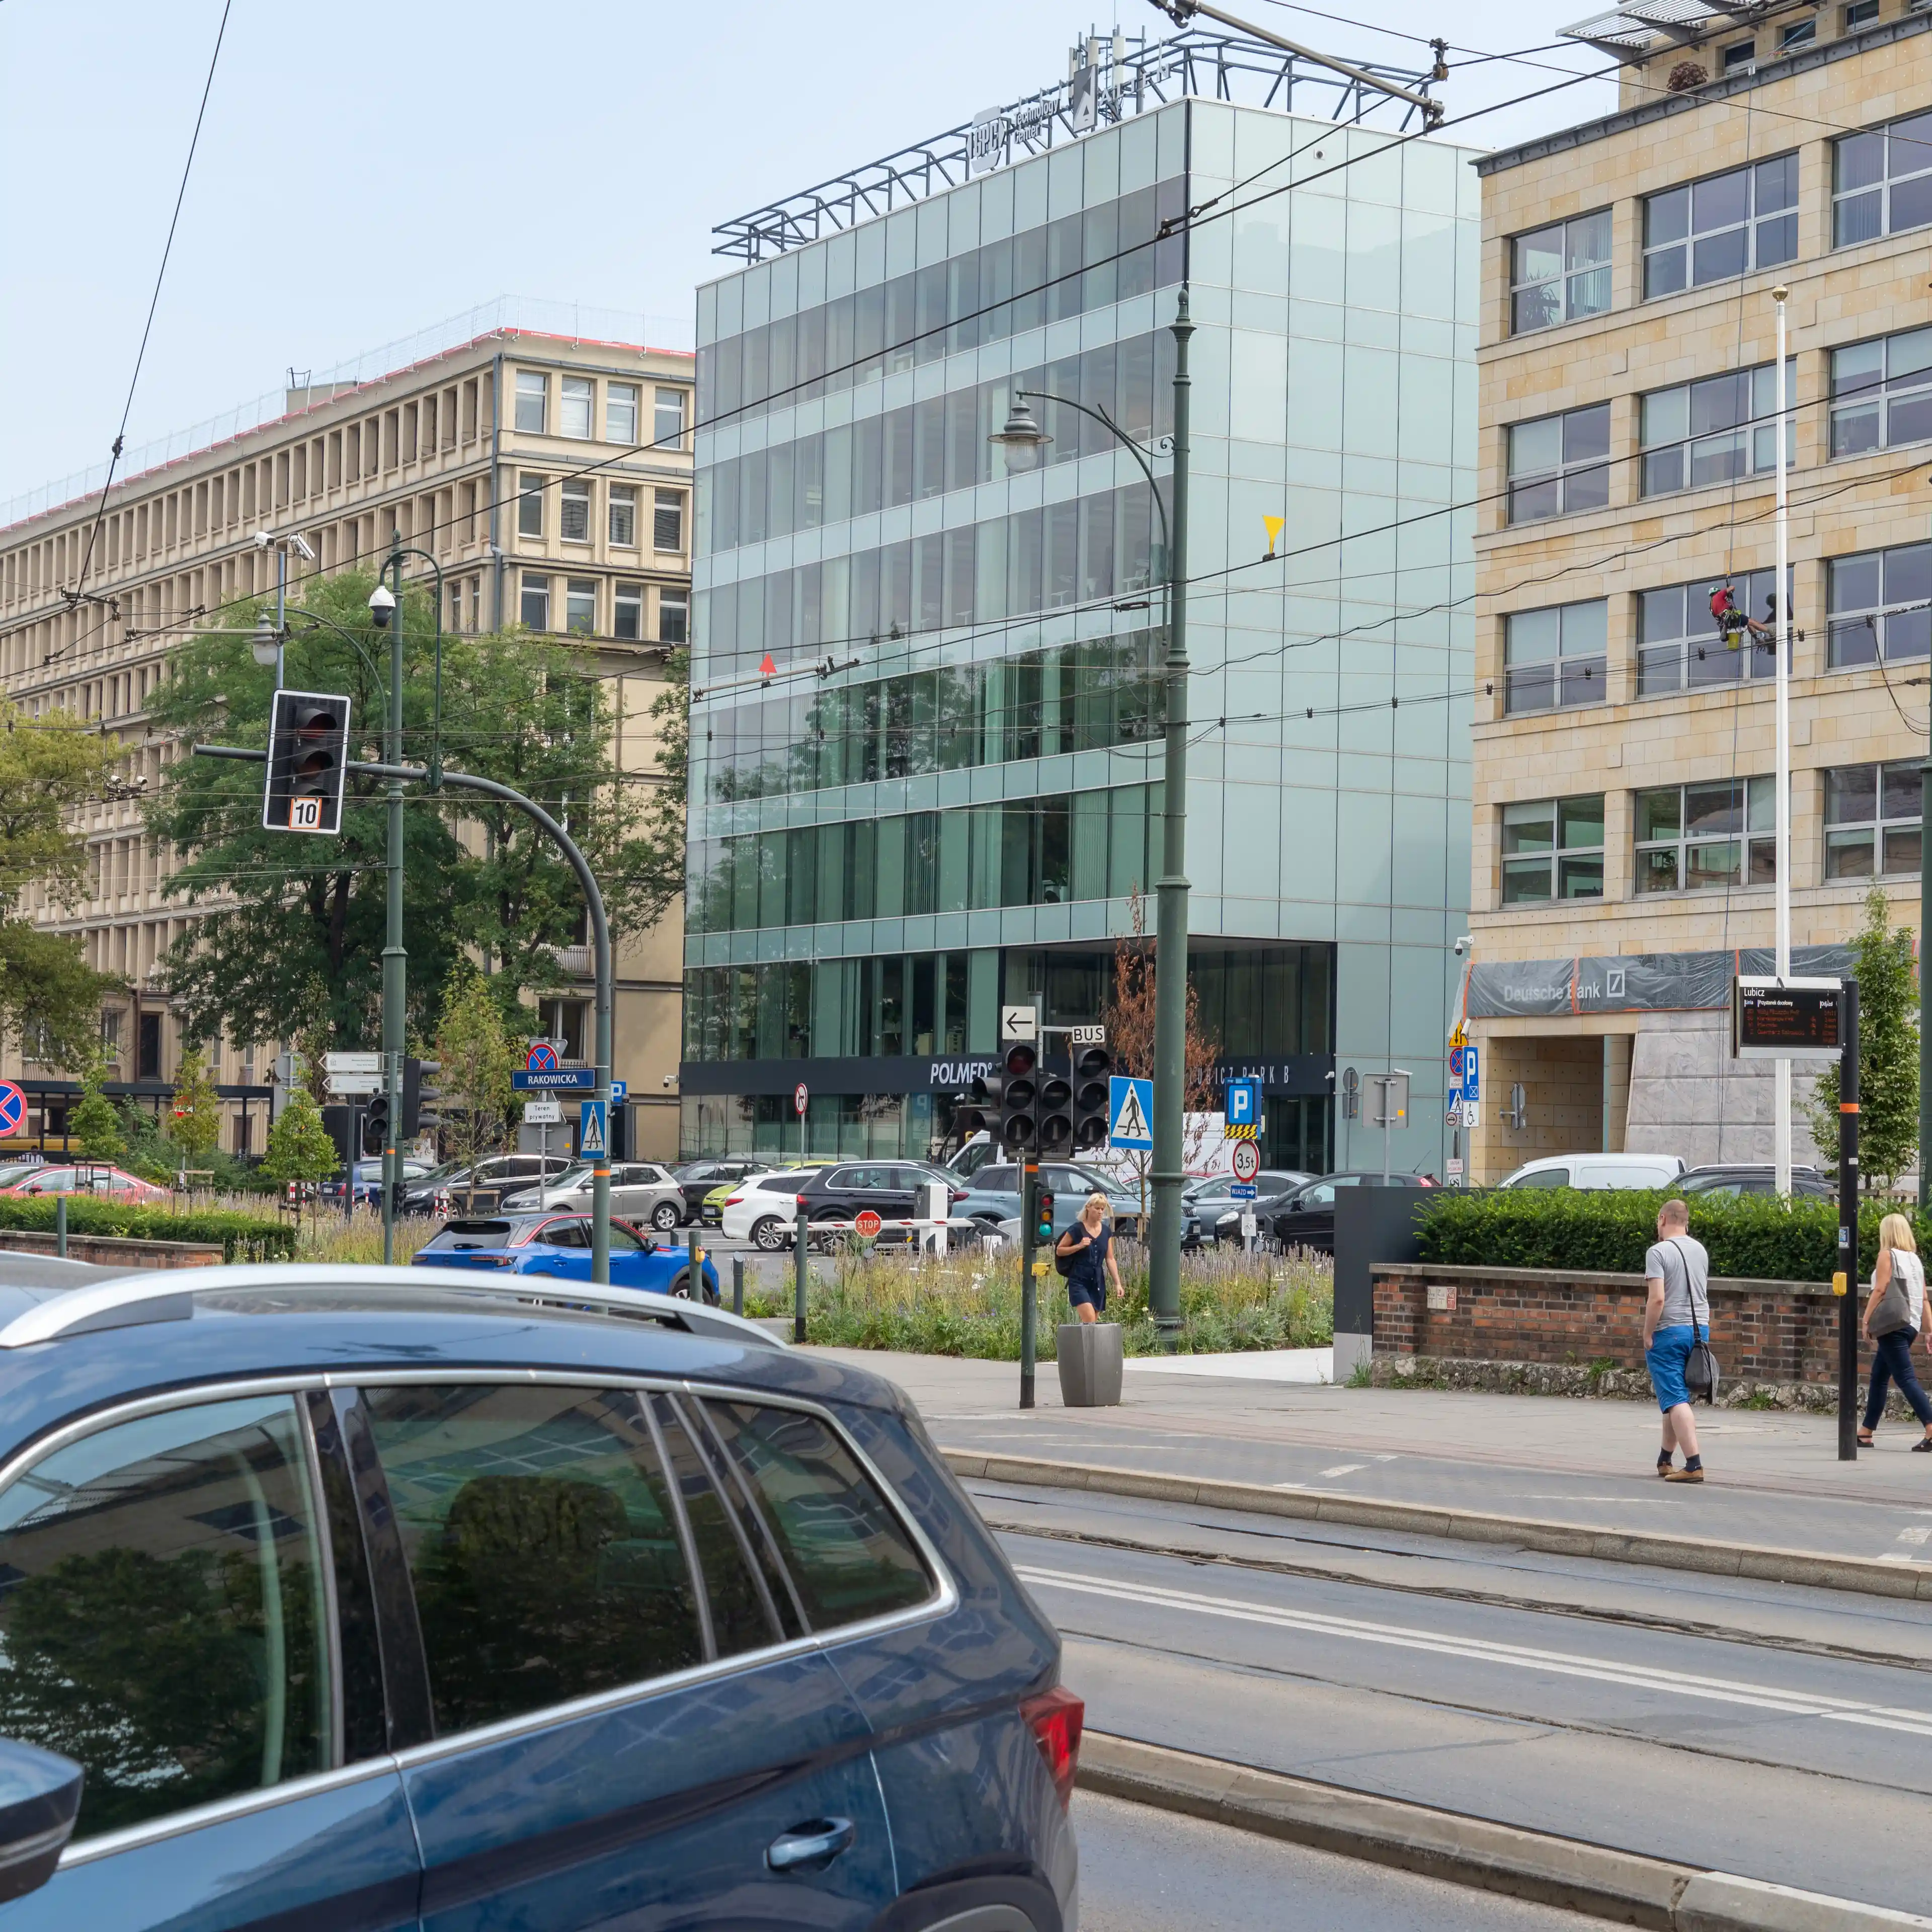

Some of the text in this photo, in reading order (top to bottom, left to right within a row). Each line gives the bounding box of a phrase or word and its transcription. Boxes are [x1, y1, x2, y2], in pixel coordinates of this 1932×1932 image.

[1014, 99, 1059, 126] Technology
[974, 122, 999, 157] GPC
[1013, 124, 1041, 144] Center
[295, 803, 316, 824] 10
[1504, 984, 1563, 1002] Deutsche
[1744, 987, 1765, 997] Lubicz
[1074, 1027, 1103, 1040] BUS
[528, 1075, 578, 1085] RAKOWICKA
[1284, 1066, 1289, 1083] B
[1234, 1090, 1248, 1118] P
[1231, 1187, 1247, 1195] WJAZD
[857, 1220, 879, 1229] STOP
